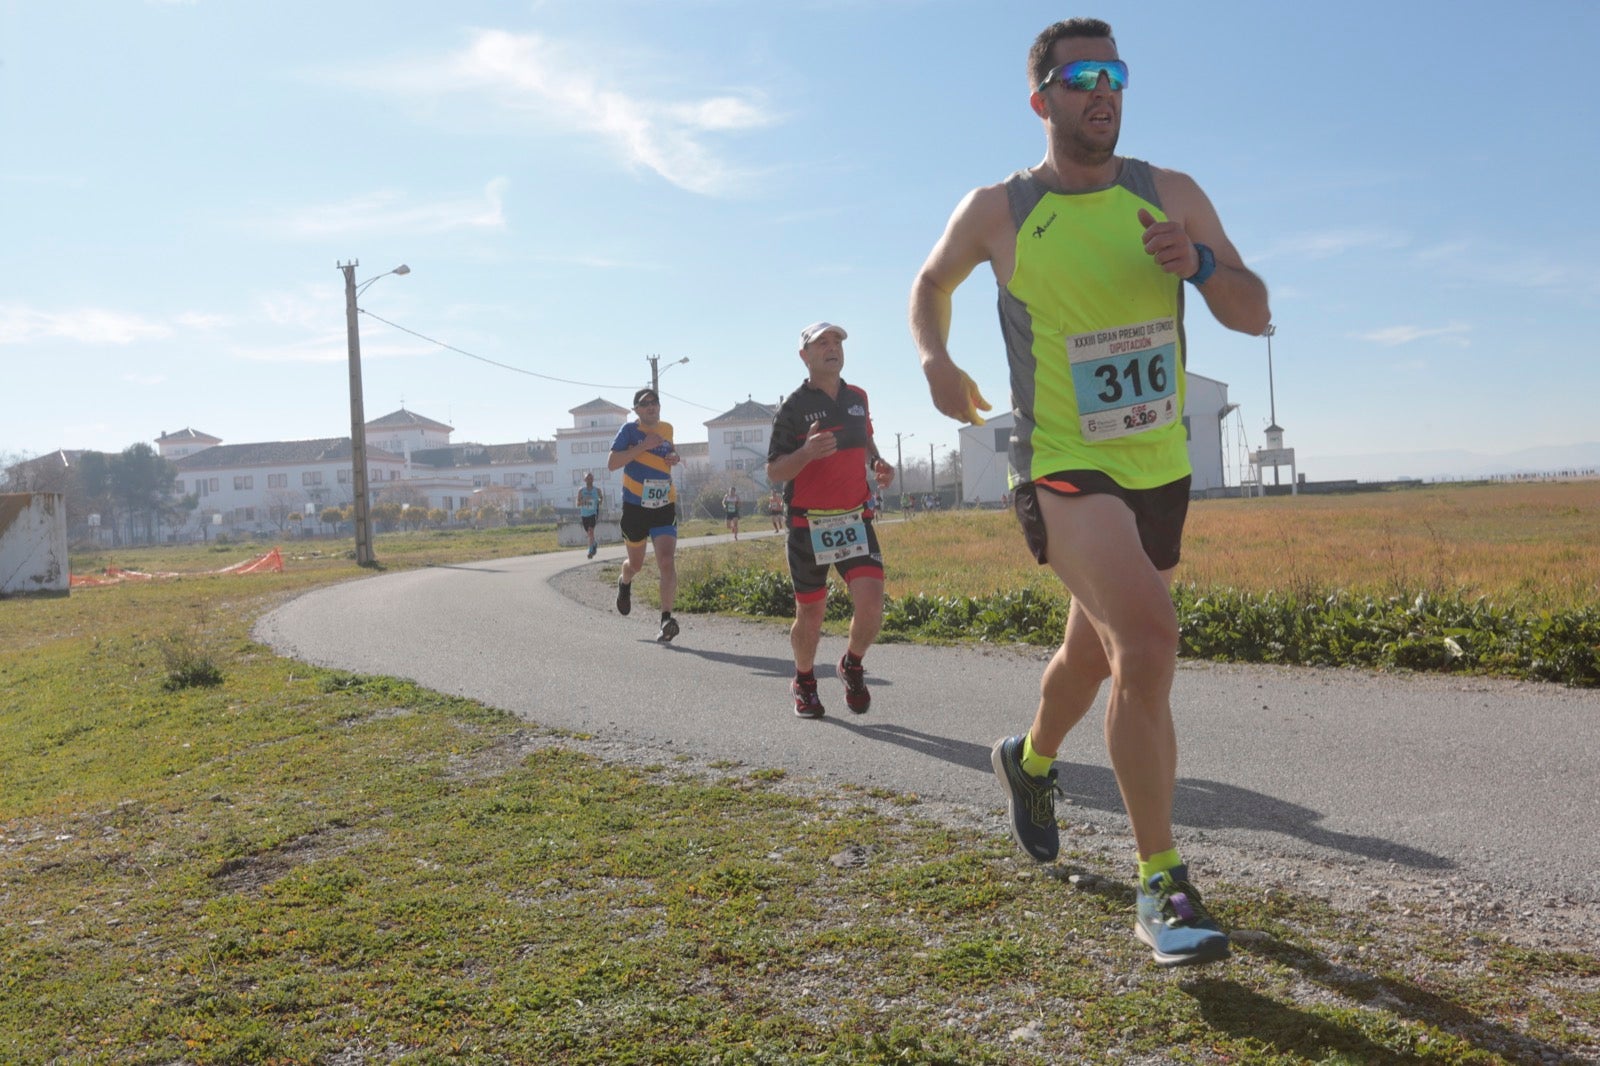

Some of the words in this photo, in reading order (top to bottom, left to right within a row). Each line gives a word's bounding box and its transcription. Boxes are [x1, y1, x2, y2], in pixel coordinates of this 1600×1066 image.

[1097, 332, 1117, 344] GRAN
[1119, 326, 1145, 339] PREMIO
[1147, 325, 1155, 335] DE
[1109, 337, 1152, 354] DIPUTACIÓN
[1094, 354, 1167, 403] 316
[821, 527, 857, 548] 628
